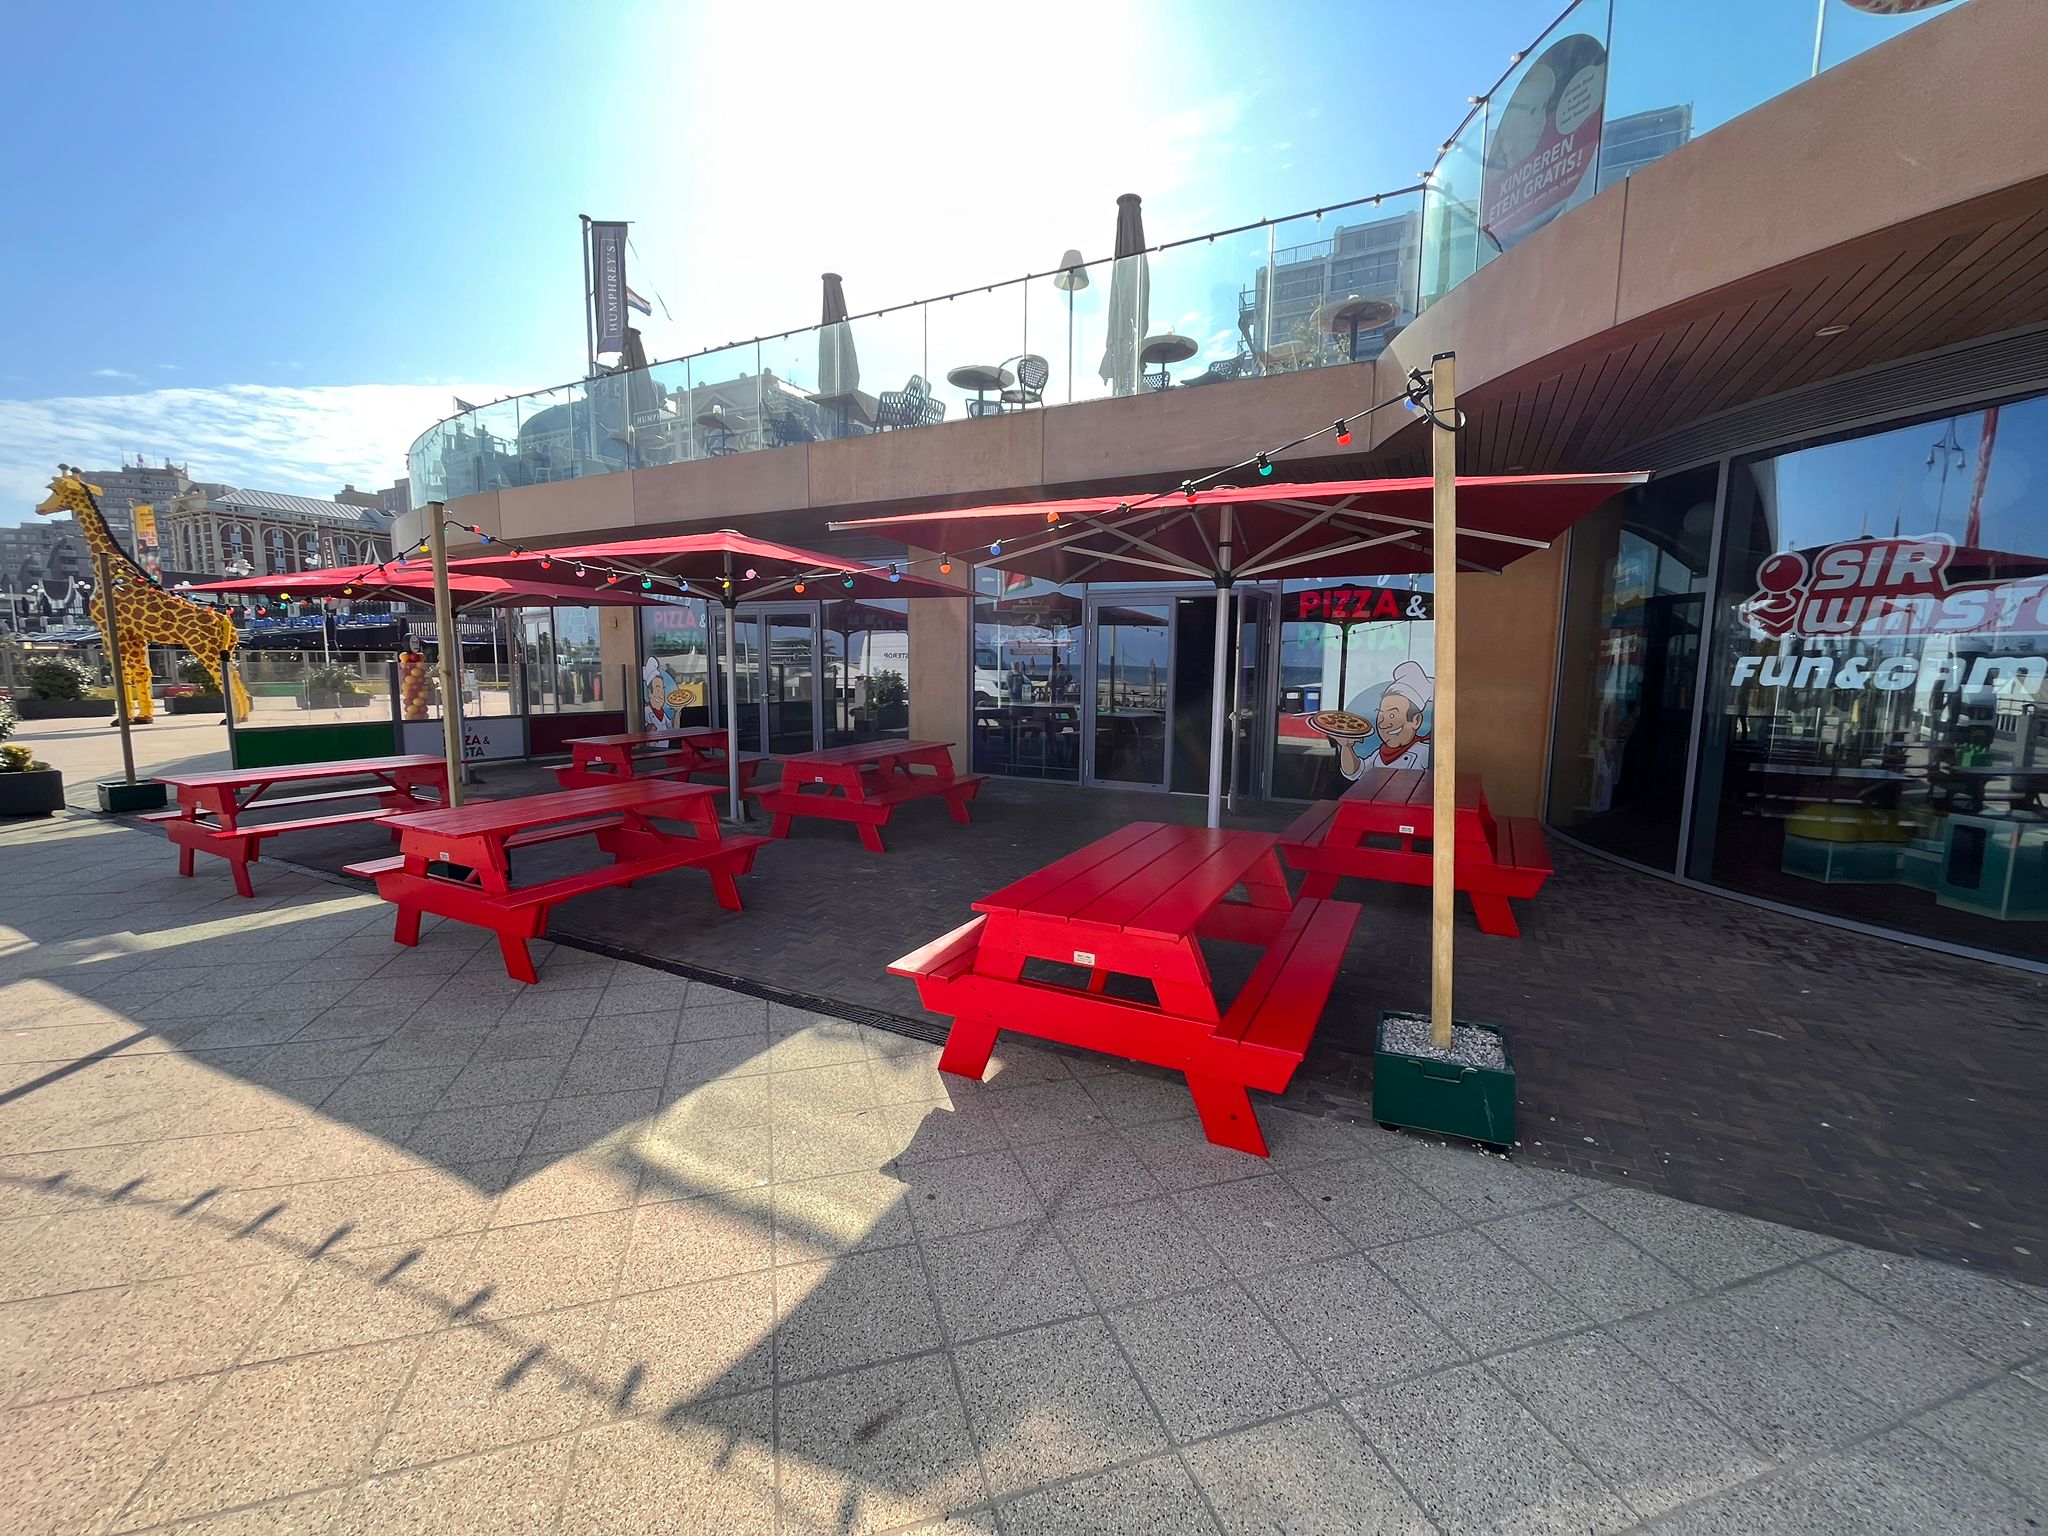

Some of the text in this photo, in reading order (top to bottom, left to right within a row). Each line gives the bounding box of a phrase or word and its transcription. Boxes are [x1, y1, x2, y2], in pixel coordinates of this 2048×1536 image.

[1488, 188, 1520, 223] ETEN
[1524, 148, 1583, 198] GRATIS!
[1500, 133, 1574, 198] KINDEREN
[606, 244, 618, 332] HUMPHREY'S
[1814, 542, 1944, 591] SIR
[655, 611, 697, 629] PIZZA
[1300, 588, 1428, 619] PIZZA &
